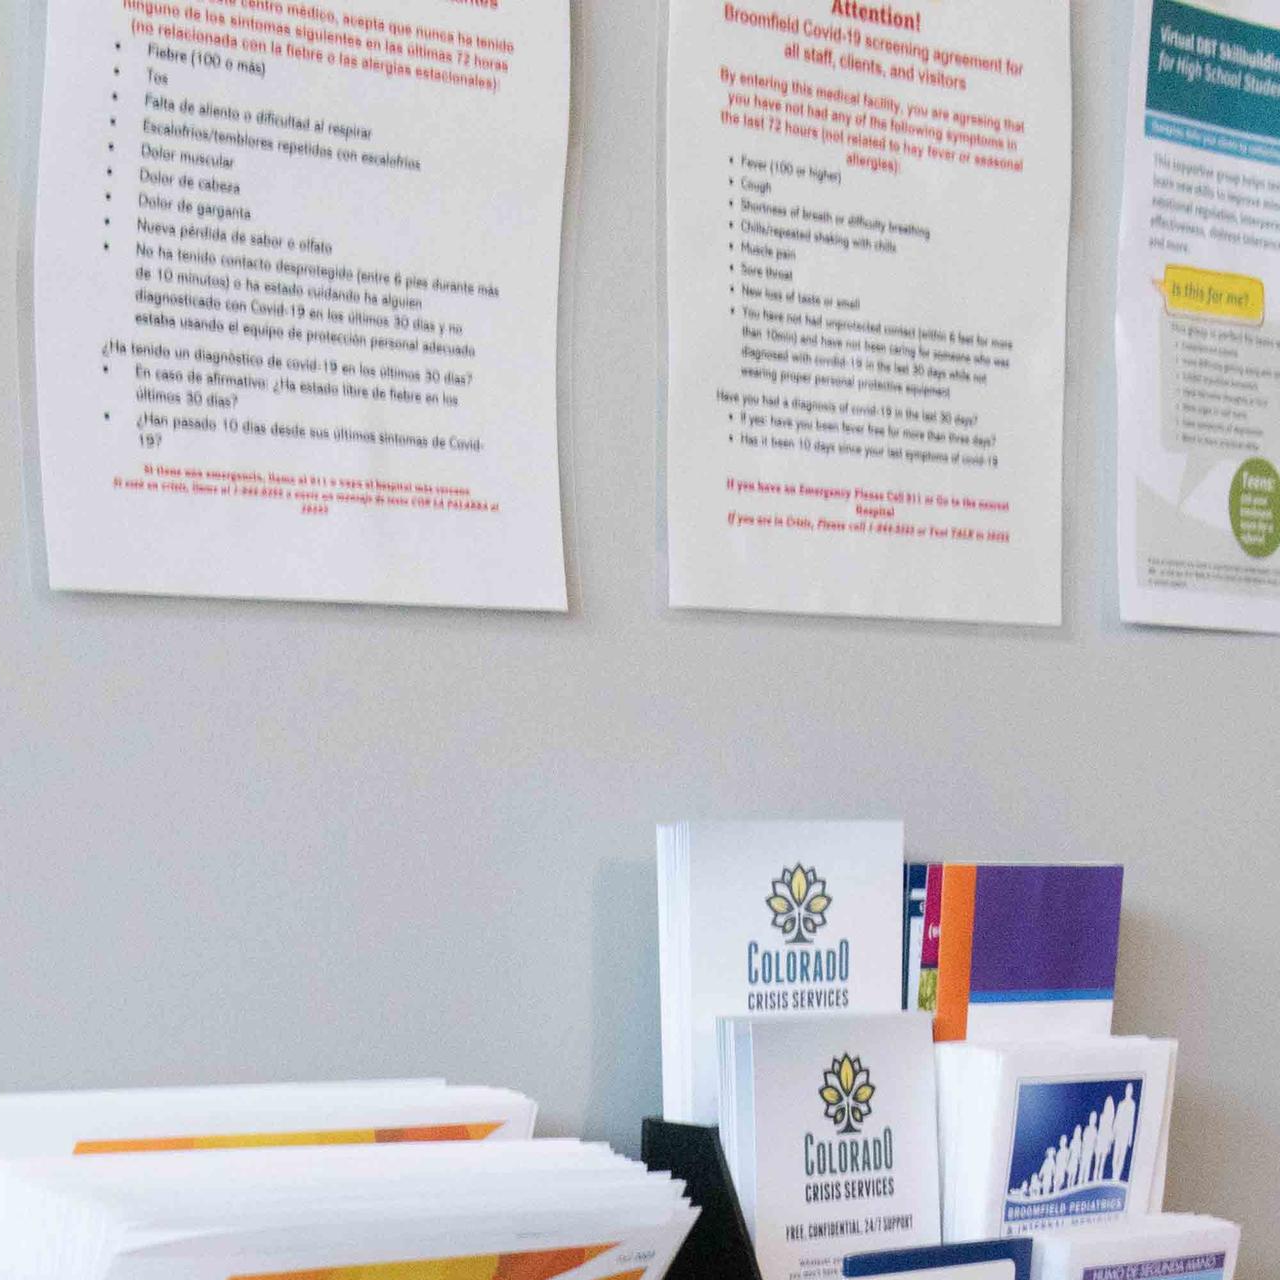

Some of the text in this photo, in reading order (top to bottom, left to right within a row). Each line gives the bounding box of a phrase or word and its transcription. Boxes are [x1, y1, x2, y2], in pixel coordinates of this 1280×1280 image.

[832, 0, 922, 32] Attention!
[724, 2, 1024, 77] Broomfield Covid-19 screening agreement for
[147, 43, 266, 79] Fiebre (100 o más)
[147, 67, 168, 86] Tos
[784, 43, 967, 91] all staff, clients, and visitors
[1158, 49, 1175, 73] for
[1176, 54, 1202, 82] High
[1204, 62, 1242, 89] School
[720, 65, 1024, 134] By entering this medical facility, you are agreeing that
[141, 142, 234, 170] Dolor muscular
[1172, 281, 1249, 307] Is this for me?
[748, 938, 849, 985] COLORADO
[748, 989, 848, 1010] CRISIS SERVICES
[804, 1127, 893, 1177] COLORADO
[805, 1177, 894, 1203] CRISIS SERVICES
[865, 1215, 882, 1234] 24/7
[884, 1214, 913, 1232] SUPPORT
[1008, 1199, 1121, 1218] BROOMFIELD PEDIATRICS
